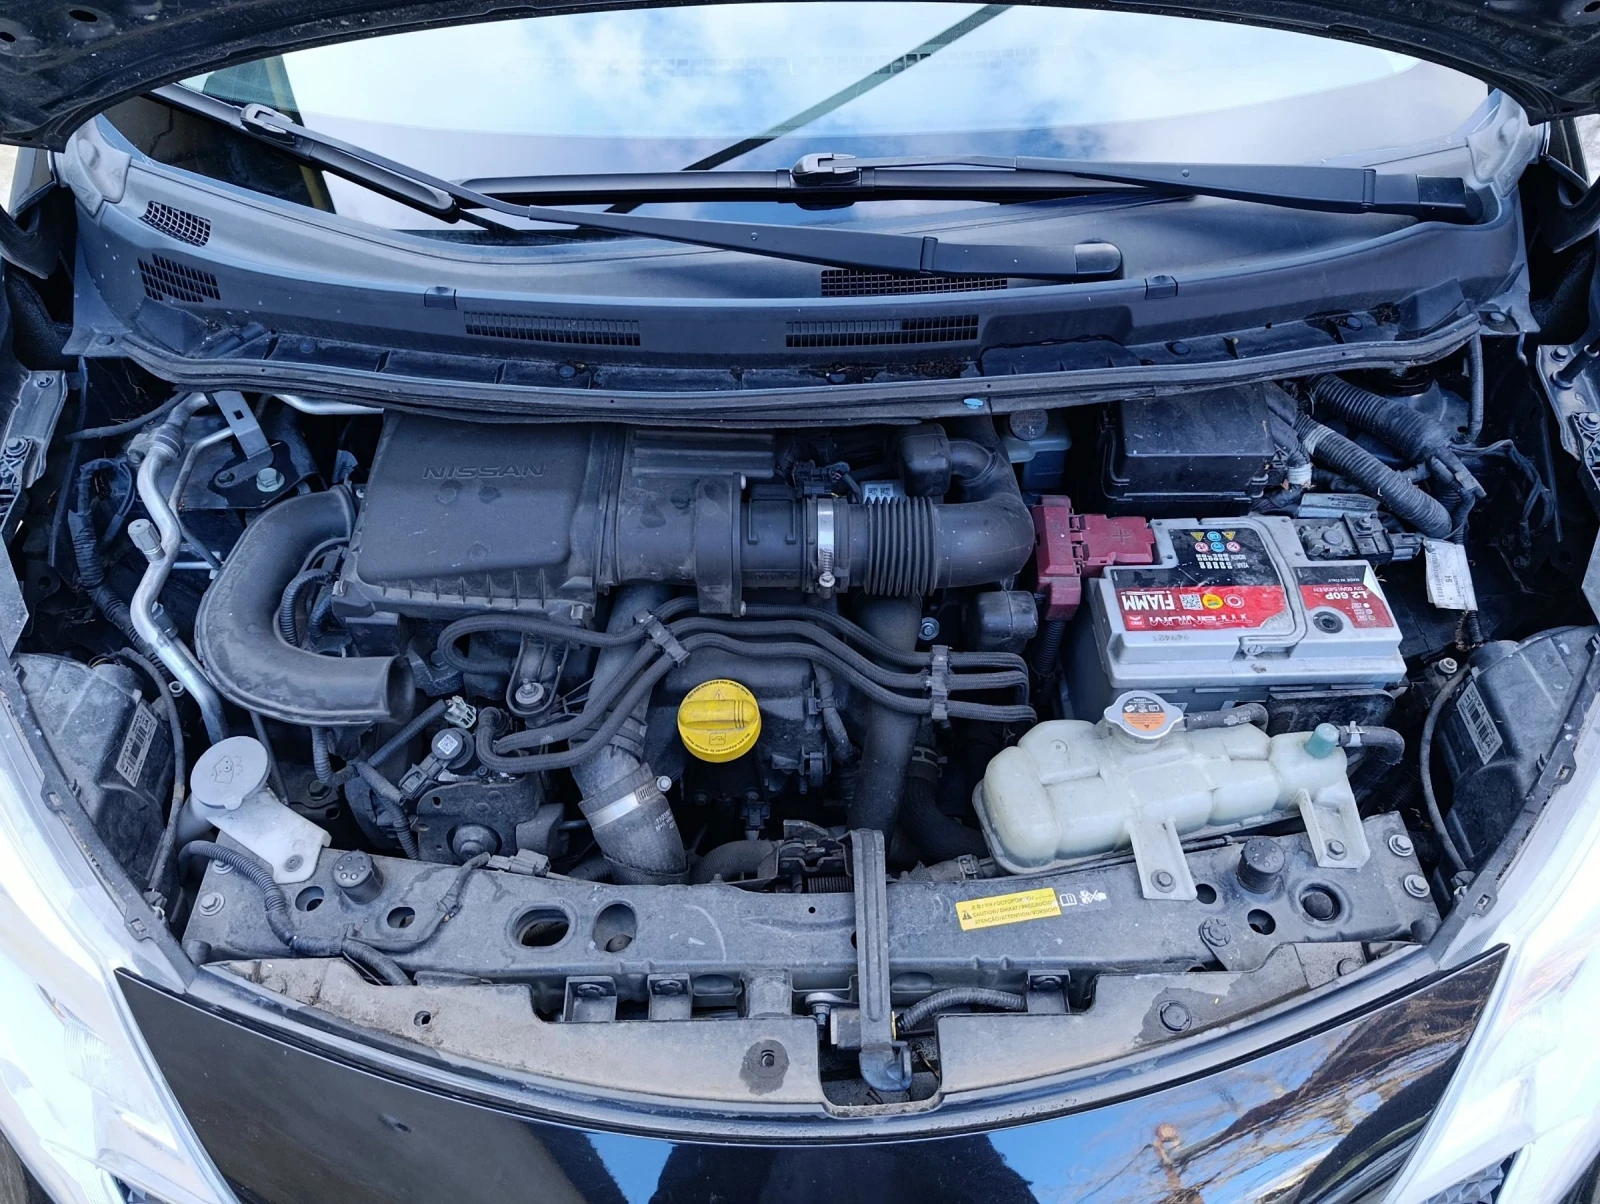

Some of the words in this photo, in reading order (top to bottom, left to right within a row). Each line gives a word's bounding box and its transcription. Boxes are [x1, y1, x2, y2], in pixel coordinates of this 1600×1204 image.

[422, 463, 545, 480] NISSAN
[1325, 591, 1349, 600] 60P
[1352, 590, 1368, 599] L2
[1122, 593, 1176, 611] FIAMM
[1148, 613, 1253, 627] TITANIUM
[700, 681, 720, 689] exceed
